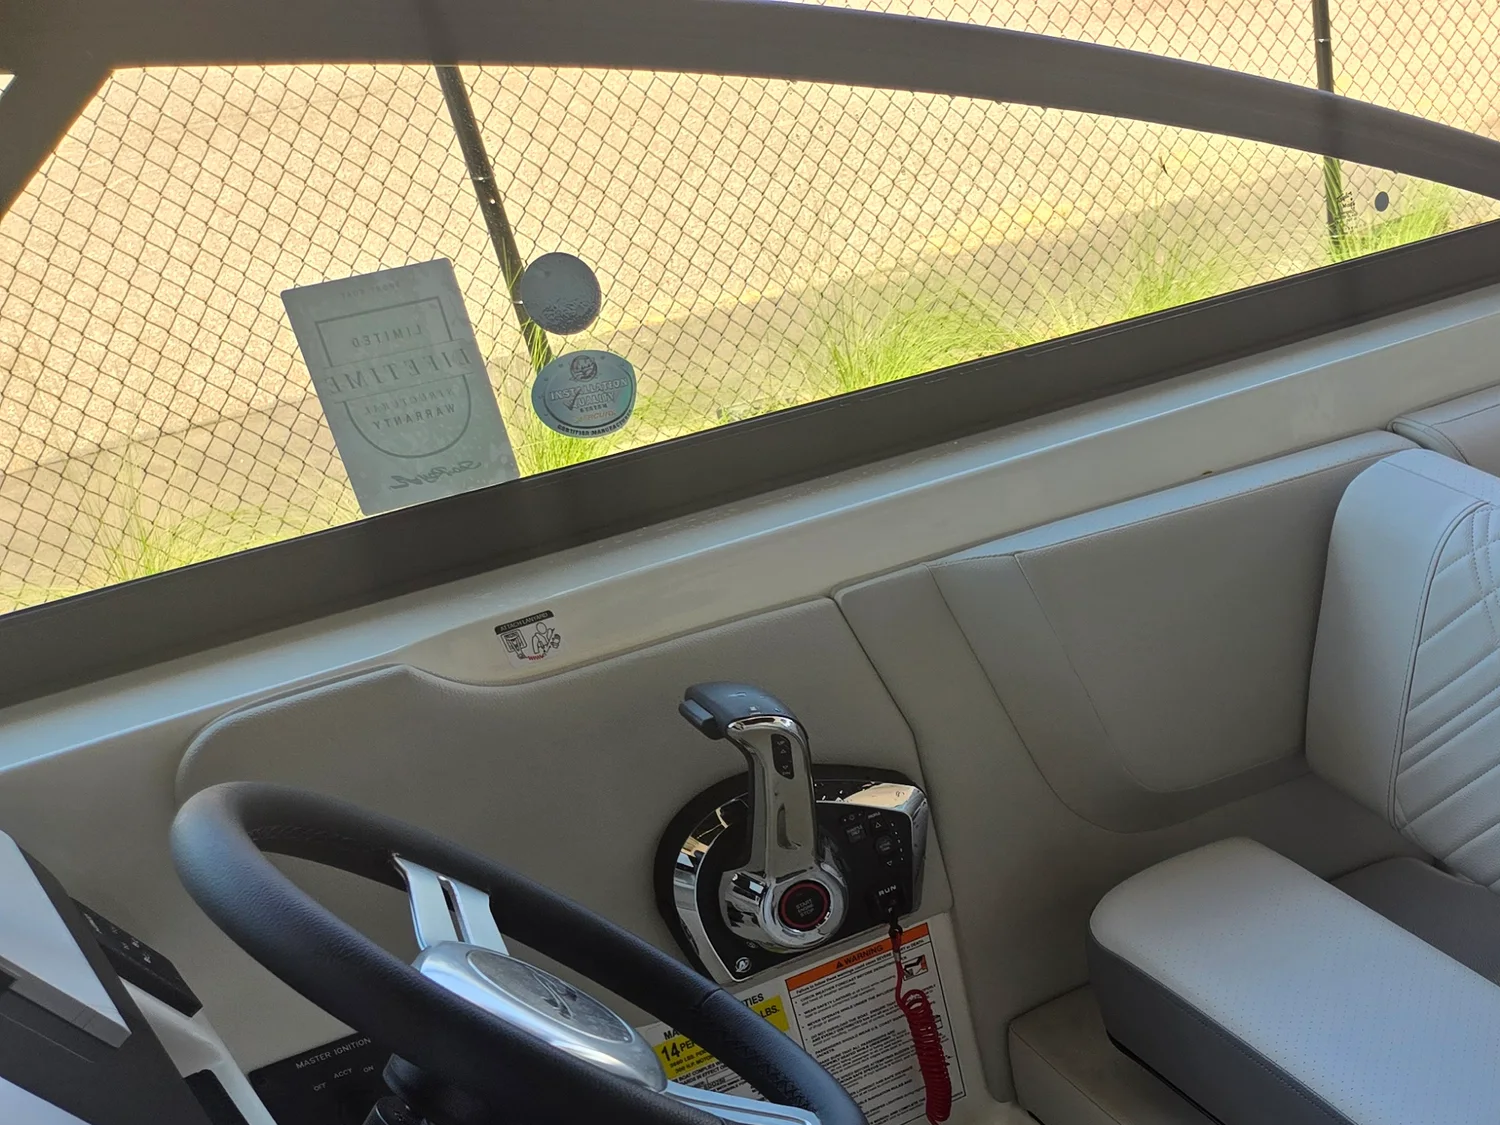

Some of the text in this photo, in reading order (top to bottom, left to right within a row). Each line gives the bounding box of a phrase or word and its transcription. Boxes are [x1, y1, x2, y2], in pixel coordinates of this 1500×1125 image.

[549, 378, 628, 401] INSTALLATION
[500, 620, 522, 632] ATTACH
[878, 884, 897, 896] RUN
[799, 908, 815, 918] STOP
[843, 943, 883, 965] WARNING
[660, 1042, 680, 1062] 14
[759, 1005, 780, 1018] LBS.
[295, 1037, 371, 1069] MASTER IGNITION
[313, 1065, 374, 1091] OFF ACCY ON
